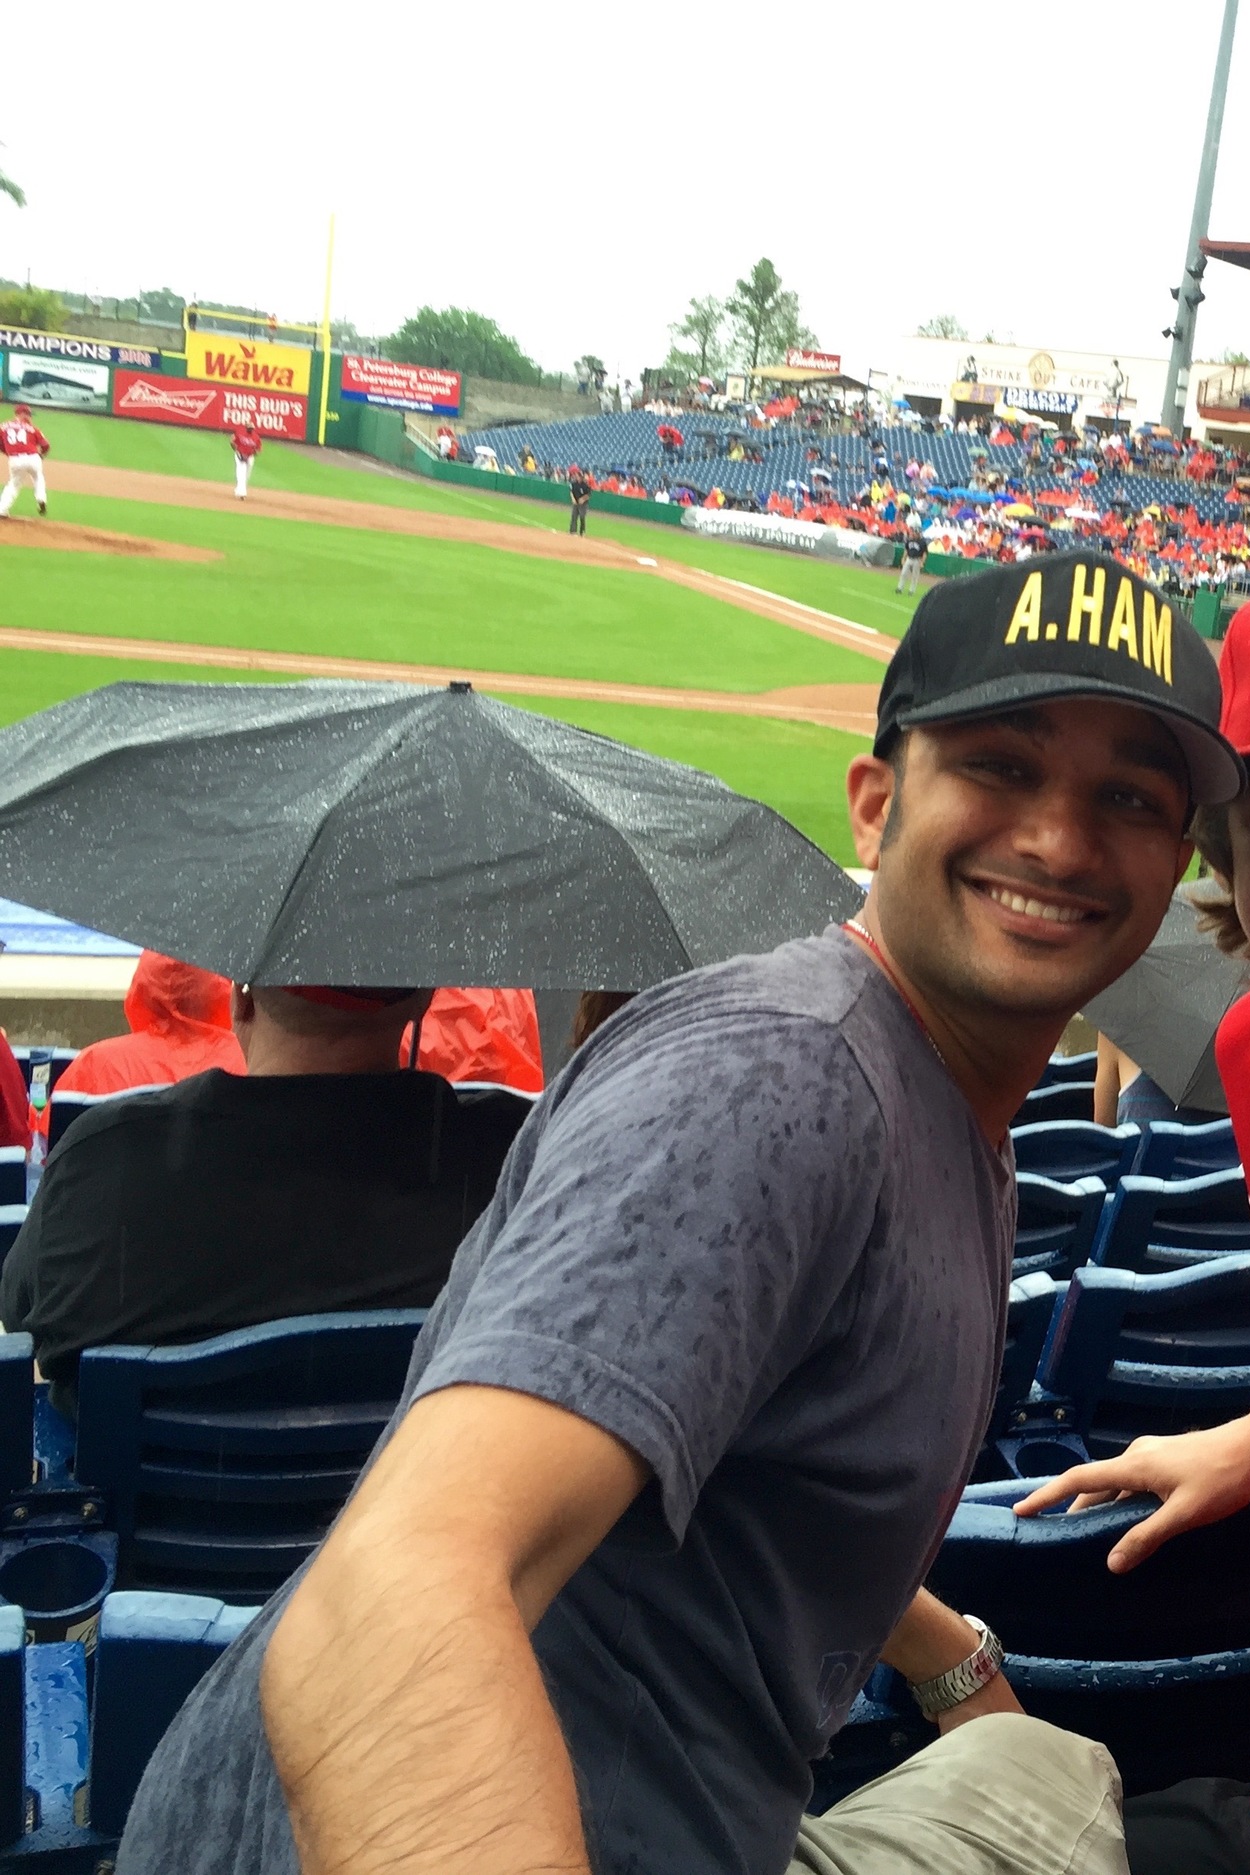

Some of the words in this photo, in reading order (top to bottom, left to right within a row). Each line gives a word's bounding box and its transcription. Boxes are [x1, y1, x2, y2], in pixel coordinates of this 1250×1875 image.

[205, 351, 294, 388] Wawa
[363, 360, 418, 381] Petersburg
[419, 368, 458, 387] College
[789, 350, 839, 371] Budweiser
[351, 370, 408, 389] Clearwater
[409, 380, 451, 396] Campus
[128, 385, 205, 410] Budweiser
[224, 391, 256, 411] THIS
[260, 397, 303, 418] BUD'S
[223, 409, 253, 428] FOR
[255, 413, 287, 432] YOU.
[1004, 563, 1172, 686] A.HAM
